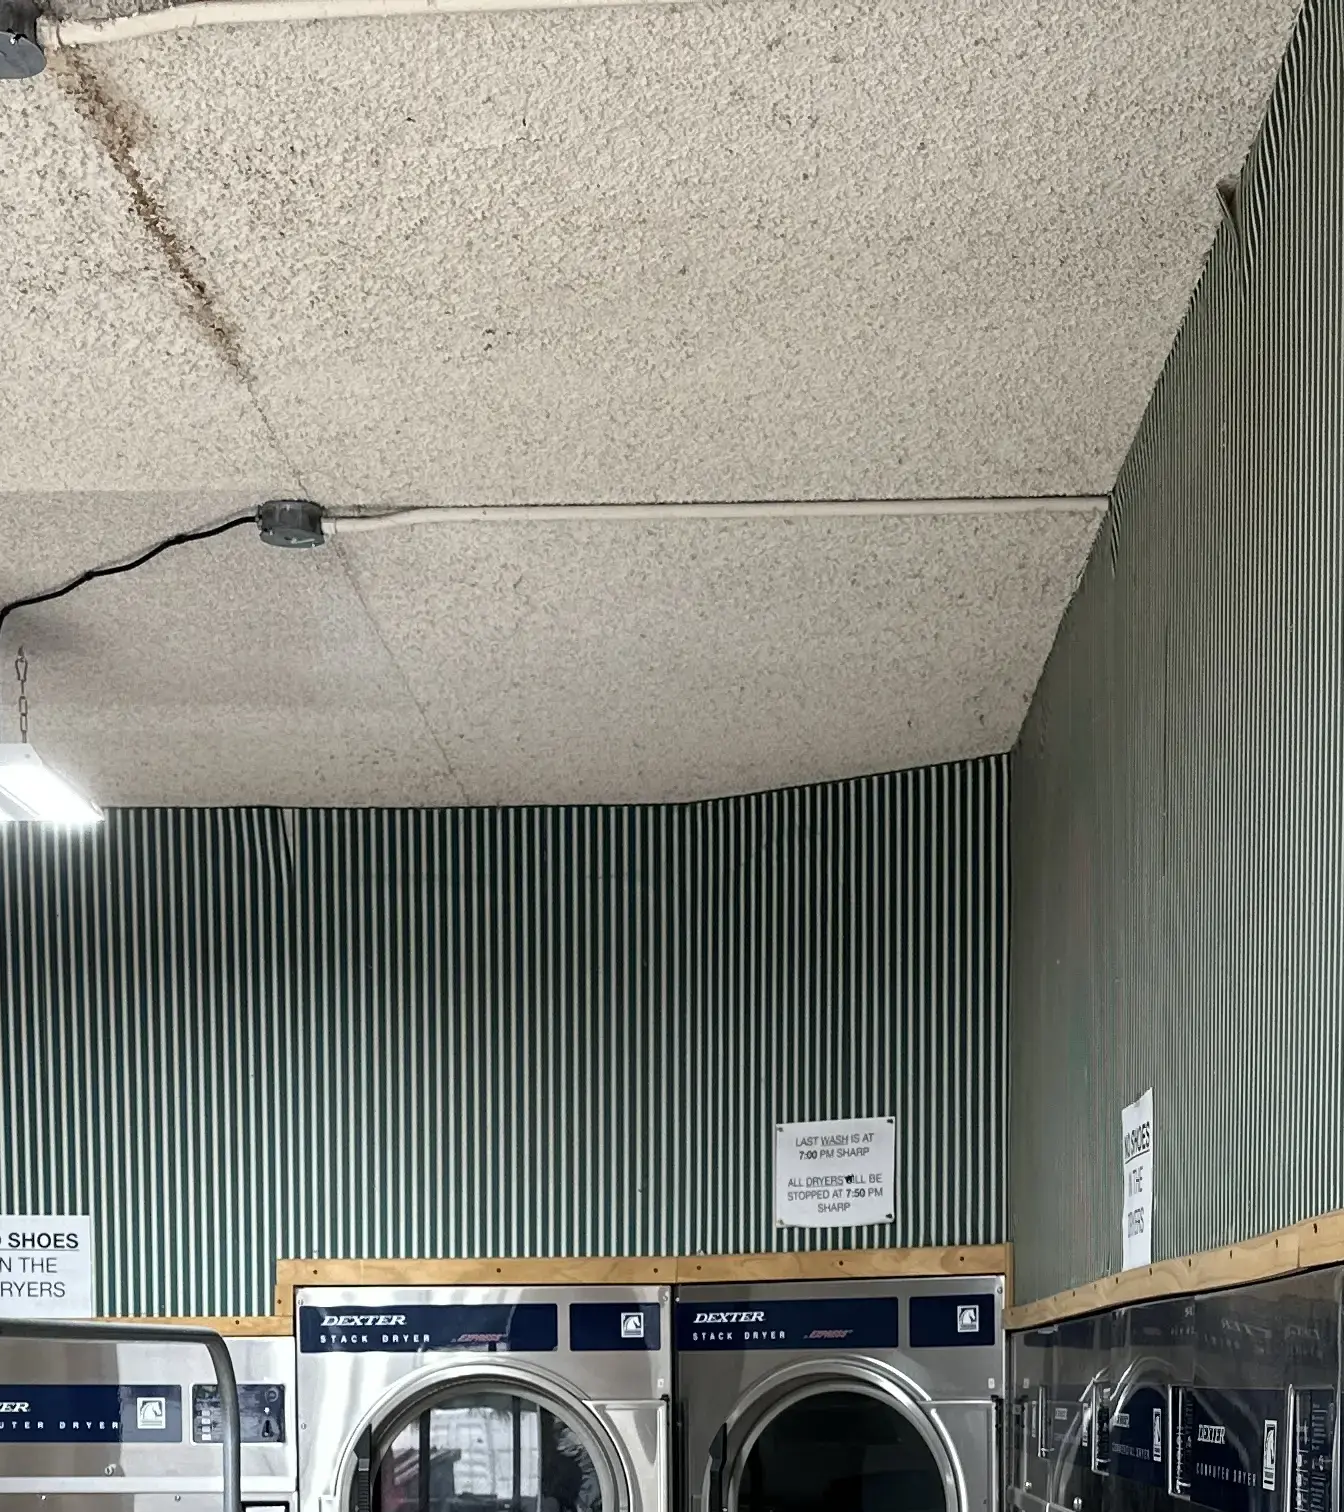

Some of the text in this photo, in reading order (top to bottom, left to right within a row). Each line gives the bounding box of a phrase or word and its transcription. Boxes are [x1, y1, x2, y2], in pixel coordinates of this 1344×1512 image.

[796, 1132, 874, 1147] LAST WASH IS AT
[799, 1147, 870, 1160] 7:00 PM SHARP
[788, 1178, 804, 1187] ALL
[806, 1175, 843, 1187] DRYERS
[869, 1173, 882, 1183] BE
[787, 1187, 883, 1201] STOPPED AT 7:50 PM
[817, 1202, 851, 1213] SHARP
[8, 1232, 79, 1248] SHOES
[18, 1257, 58, 1273] THE
[320, 1315, 407, 1326] DEXTER
[693, 1311, 765, 1323] DEXTER
[320, 1334, 430, 1343] STACK DRYER
[693, 1331, 786, 1341] STACK DRYER
[59, 1421, 119, 1430] DRYER
[1197, 1424, 1226, 1444] DEXTER
[1196, 1462, 1256, 1487] COMPUTER DRYER
